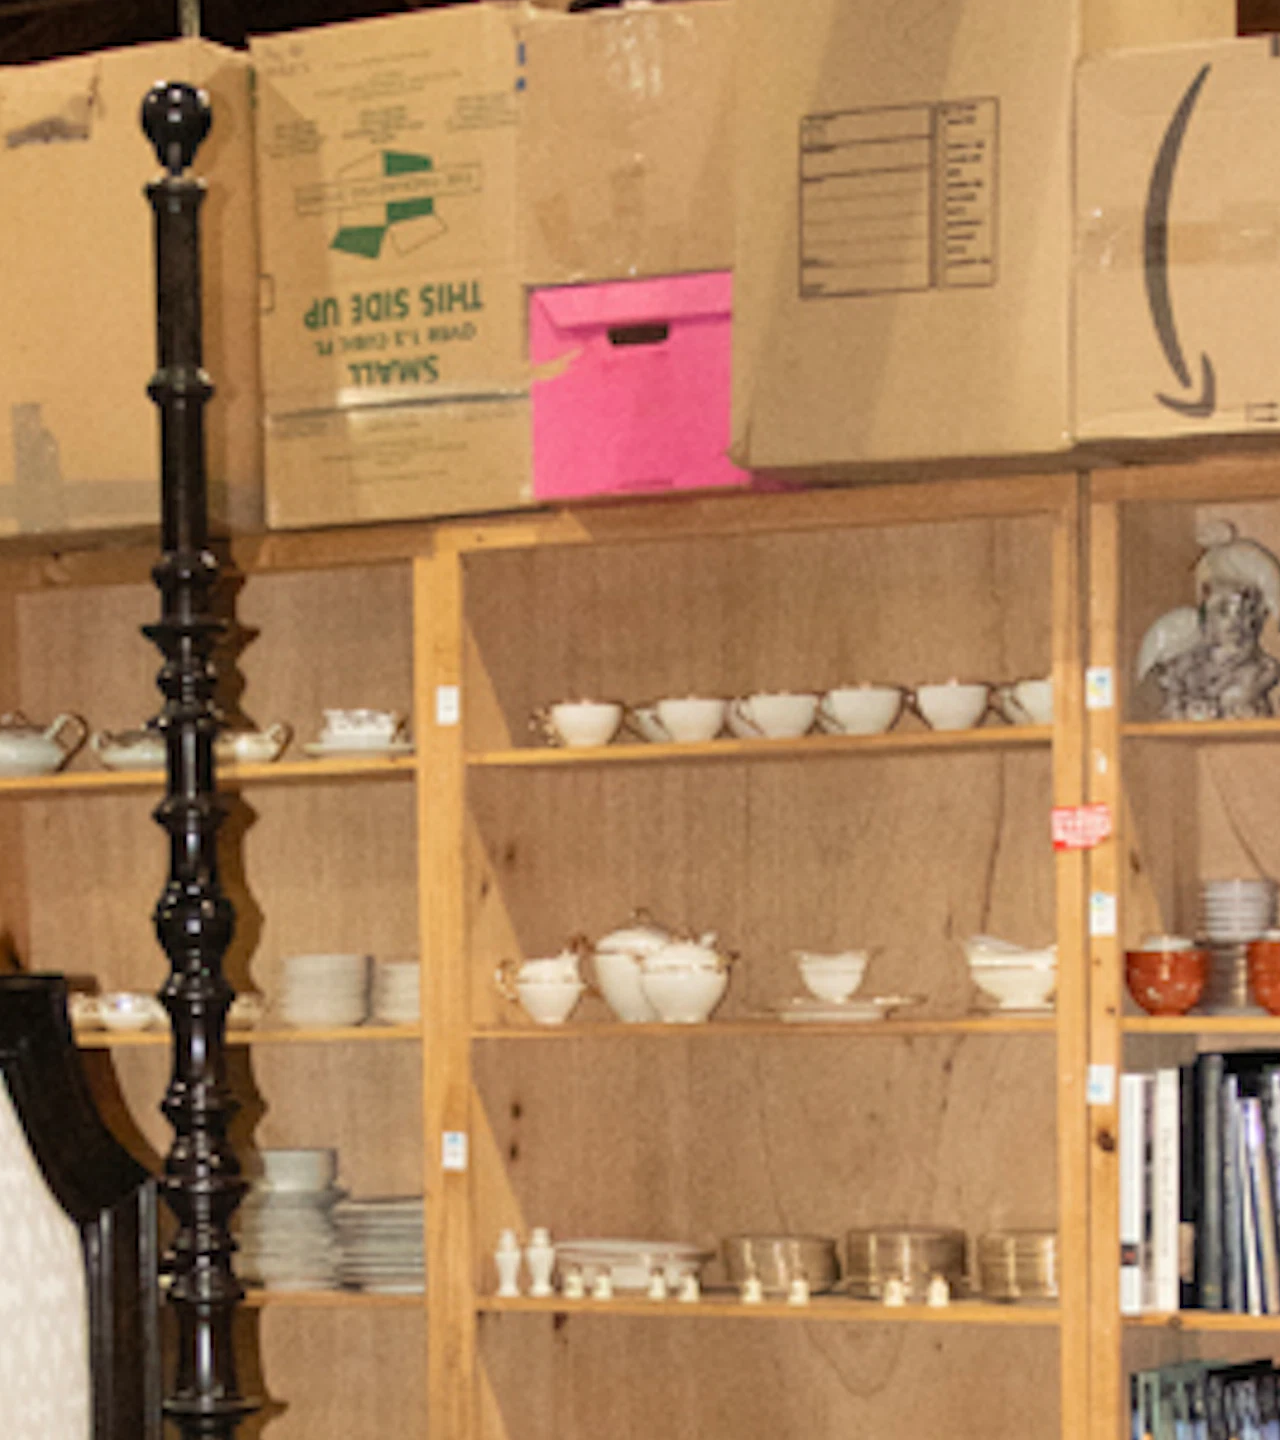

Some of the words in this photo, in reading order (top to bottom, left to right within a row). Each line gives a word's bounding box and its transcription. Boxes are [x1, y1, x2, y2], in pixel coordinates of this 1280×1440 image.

[303, 296, 340, 330] UP
[351, 286, 410, 324] SIDE
[419, 280, 483, 318] THIS
[348, 354, 439, 385] SMALL
